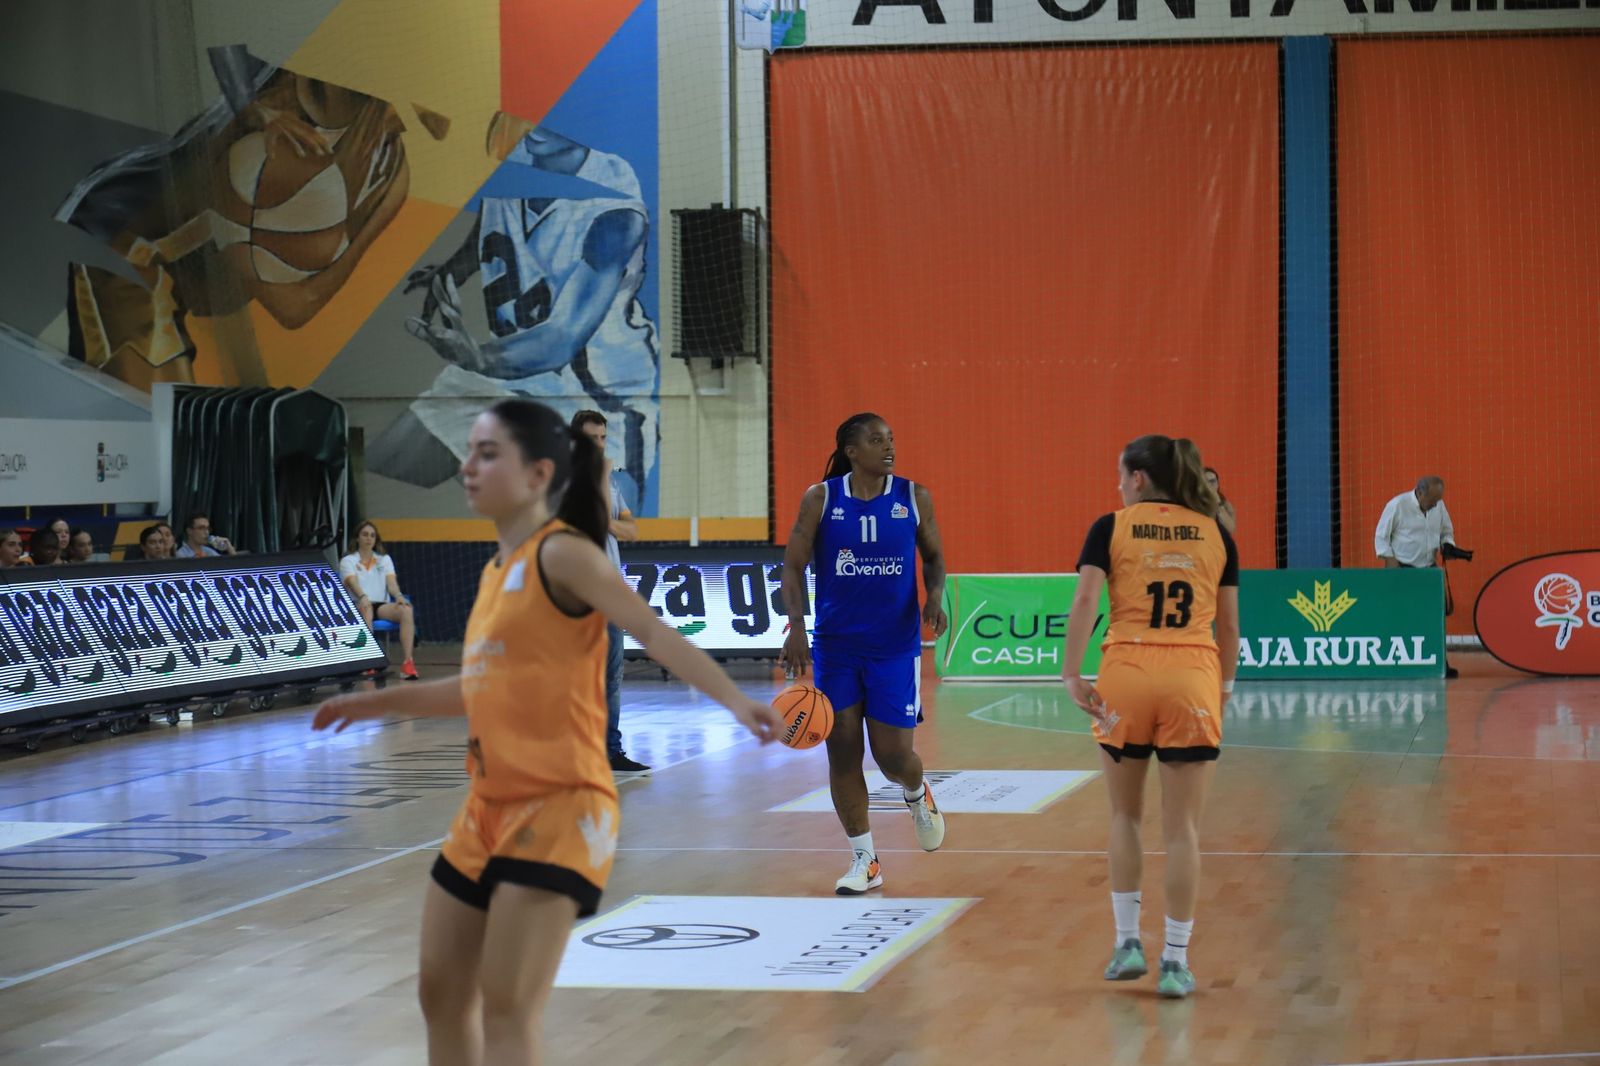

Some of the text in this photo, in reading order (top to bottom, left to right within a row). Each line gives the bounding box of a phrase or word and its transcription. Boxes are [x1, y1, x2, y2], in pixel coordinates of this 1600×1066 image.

[859, 515, 877, 543] 11
[1132, 523, 1171, 541] MARTA
[1146, 580, 1194, 629] 13
[971, 646, 1058, 665] CASH
[1237, 636, 1437, 668] AJA RURAL
[840, 907, 933, 932] PLATA
[821, 931, 899, 944] LA
[800, 944, 880, 958] DE
